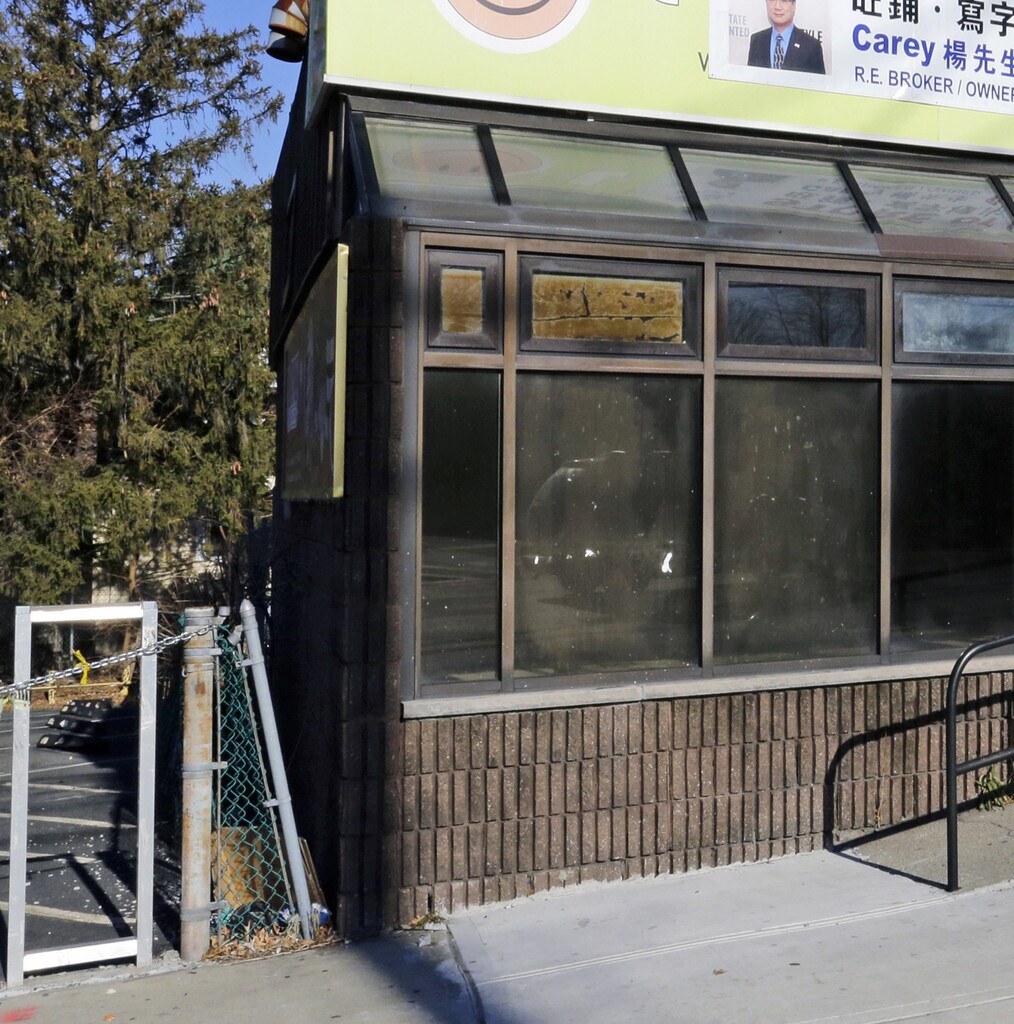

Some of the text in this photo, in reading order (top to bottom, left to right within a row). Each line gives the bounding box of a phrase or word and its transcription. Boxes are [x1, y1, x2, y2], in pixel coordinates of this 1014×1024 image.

[853, 24, 935, 67] Carey
[855, 66, 883, 85] R.E.
[889, 70, 953, 94] BROKER
